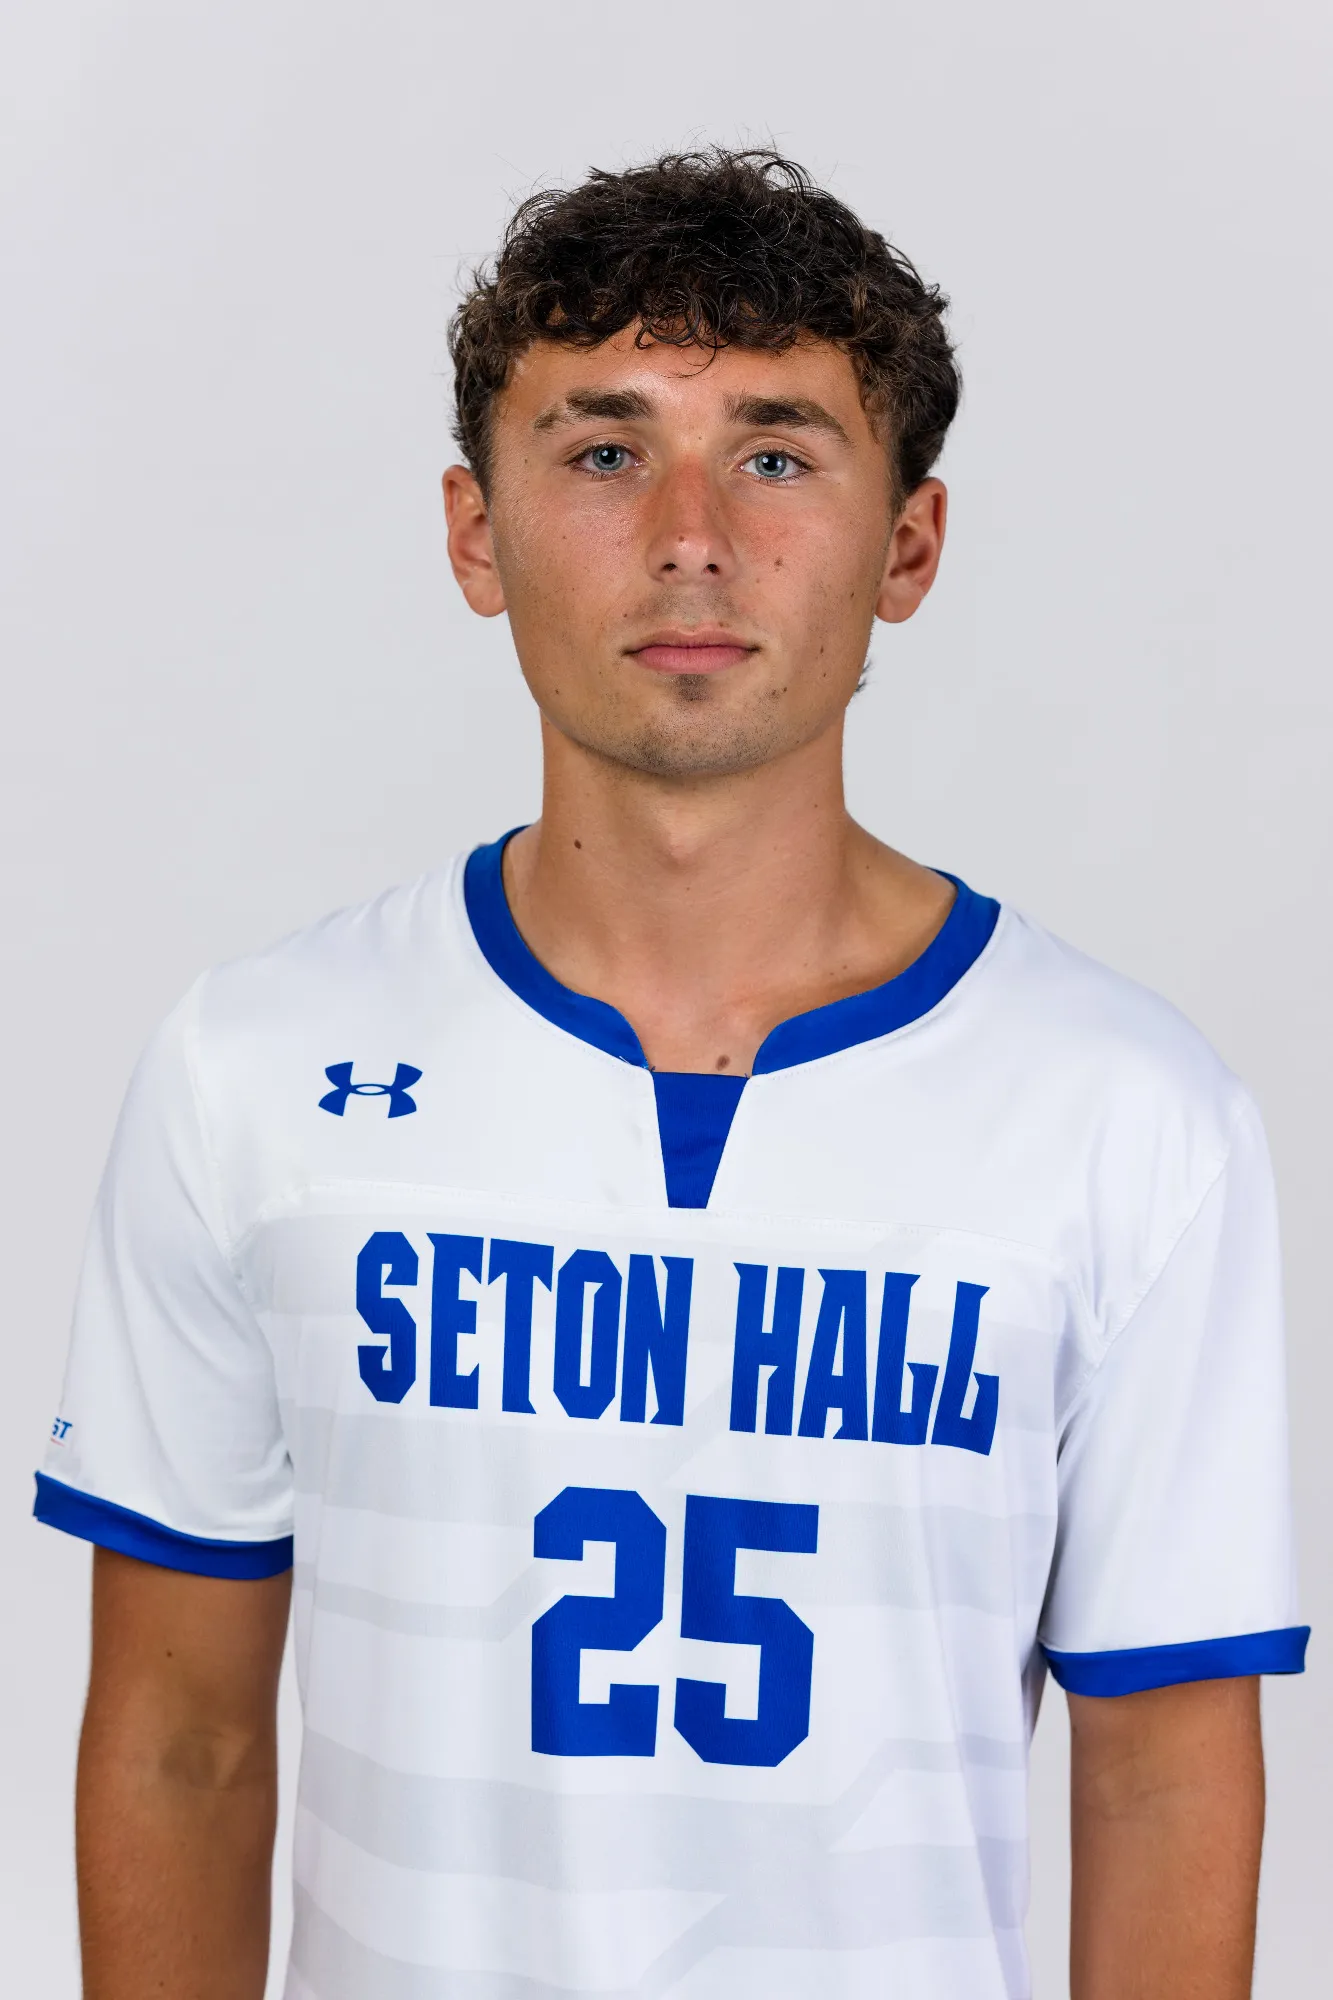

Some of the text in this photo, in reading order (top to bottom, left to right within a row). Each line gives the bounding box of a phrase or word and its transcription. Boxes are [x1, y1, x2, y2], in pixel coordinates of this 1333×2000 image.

[356, 1232, 999, 1456] SETON HALL
[532, 1486, 819, 1767] 25
